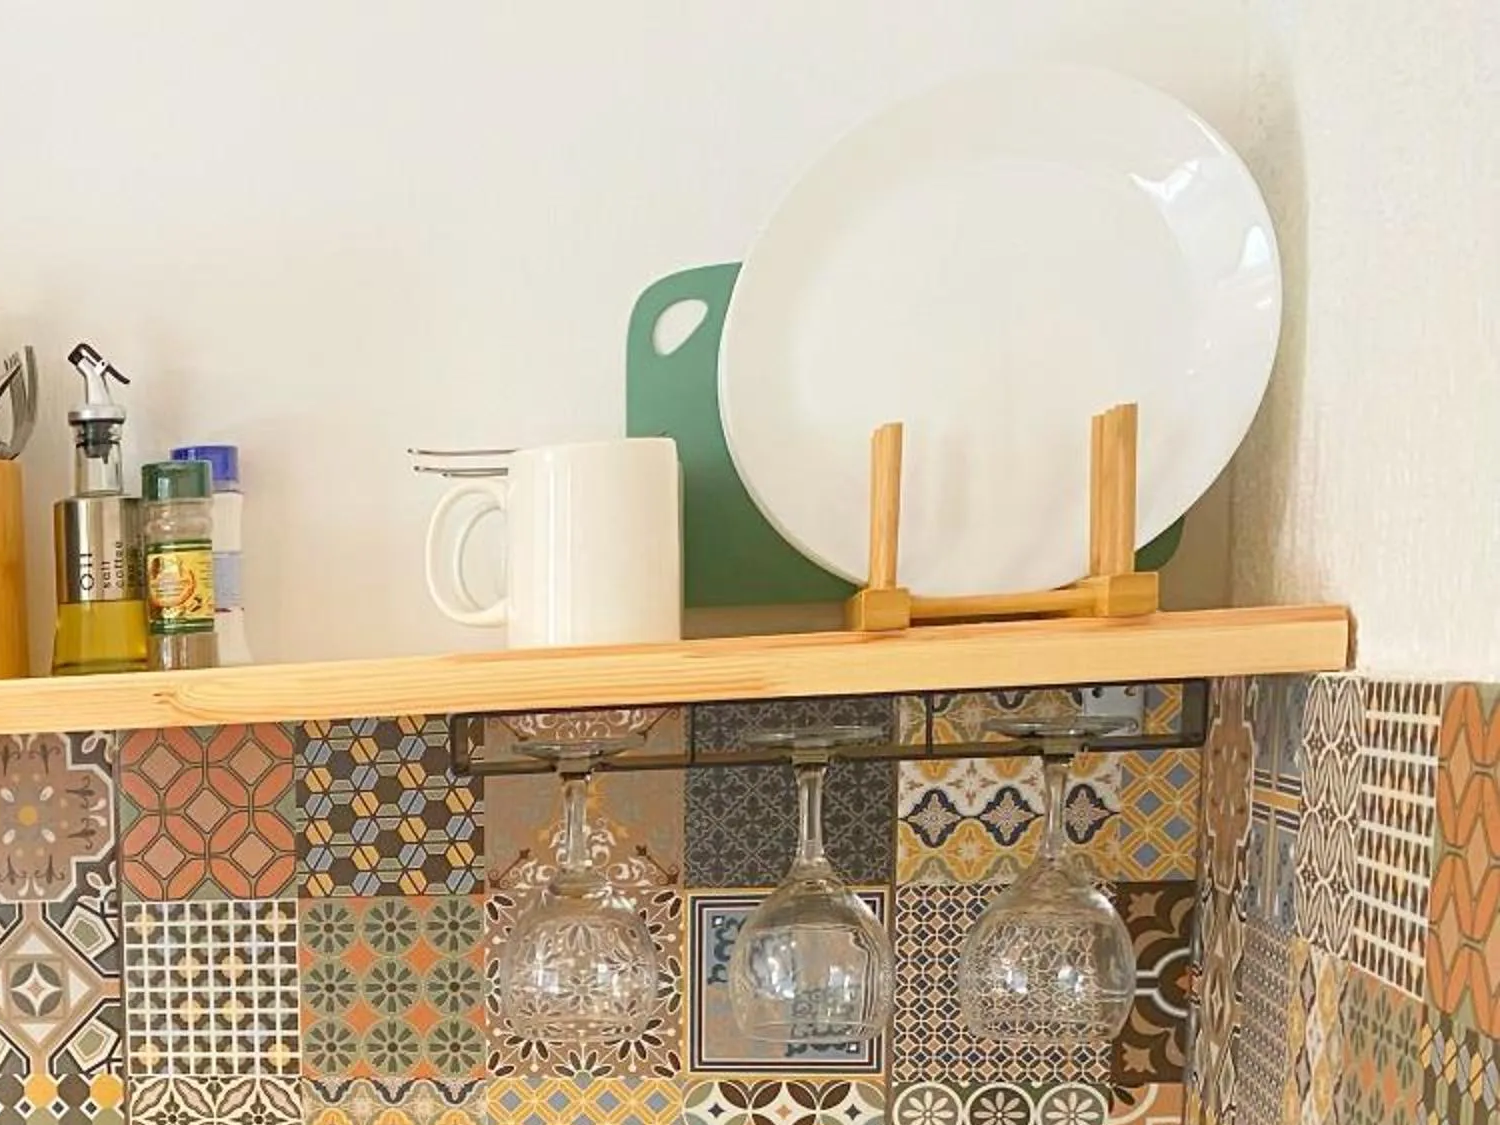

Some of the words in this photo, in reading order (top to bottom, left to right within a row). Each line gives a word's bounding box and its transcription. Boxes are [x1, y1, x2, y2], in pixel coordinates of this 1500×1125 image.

[79, 552, 94, 591] Oil
[100, 561, 111, 589] salt
[114, 541, 124, 590] coffee
